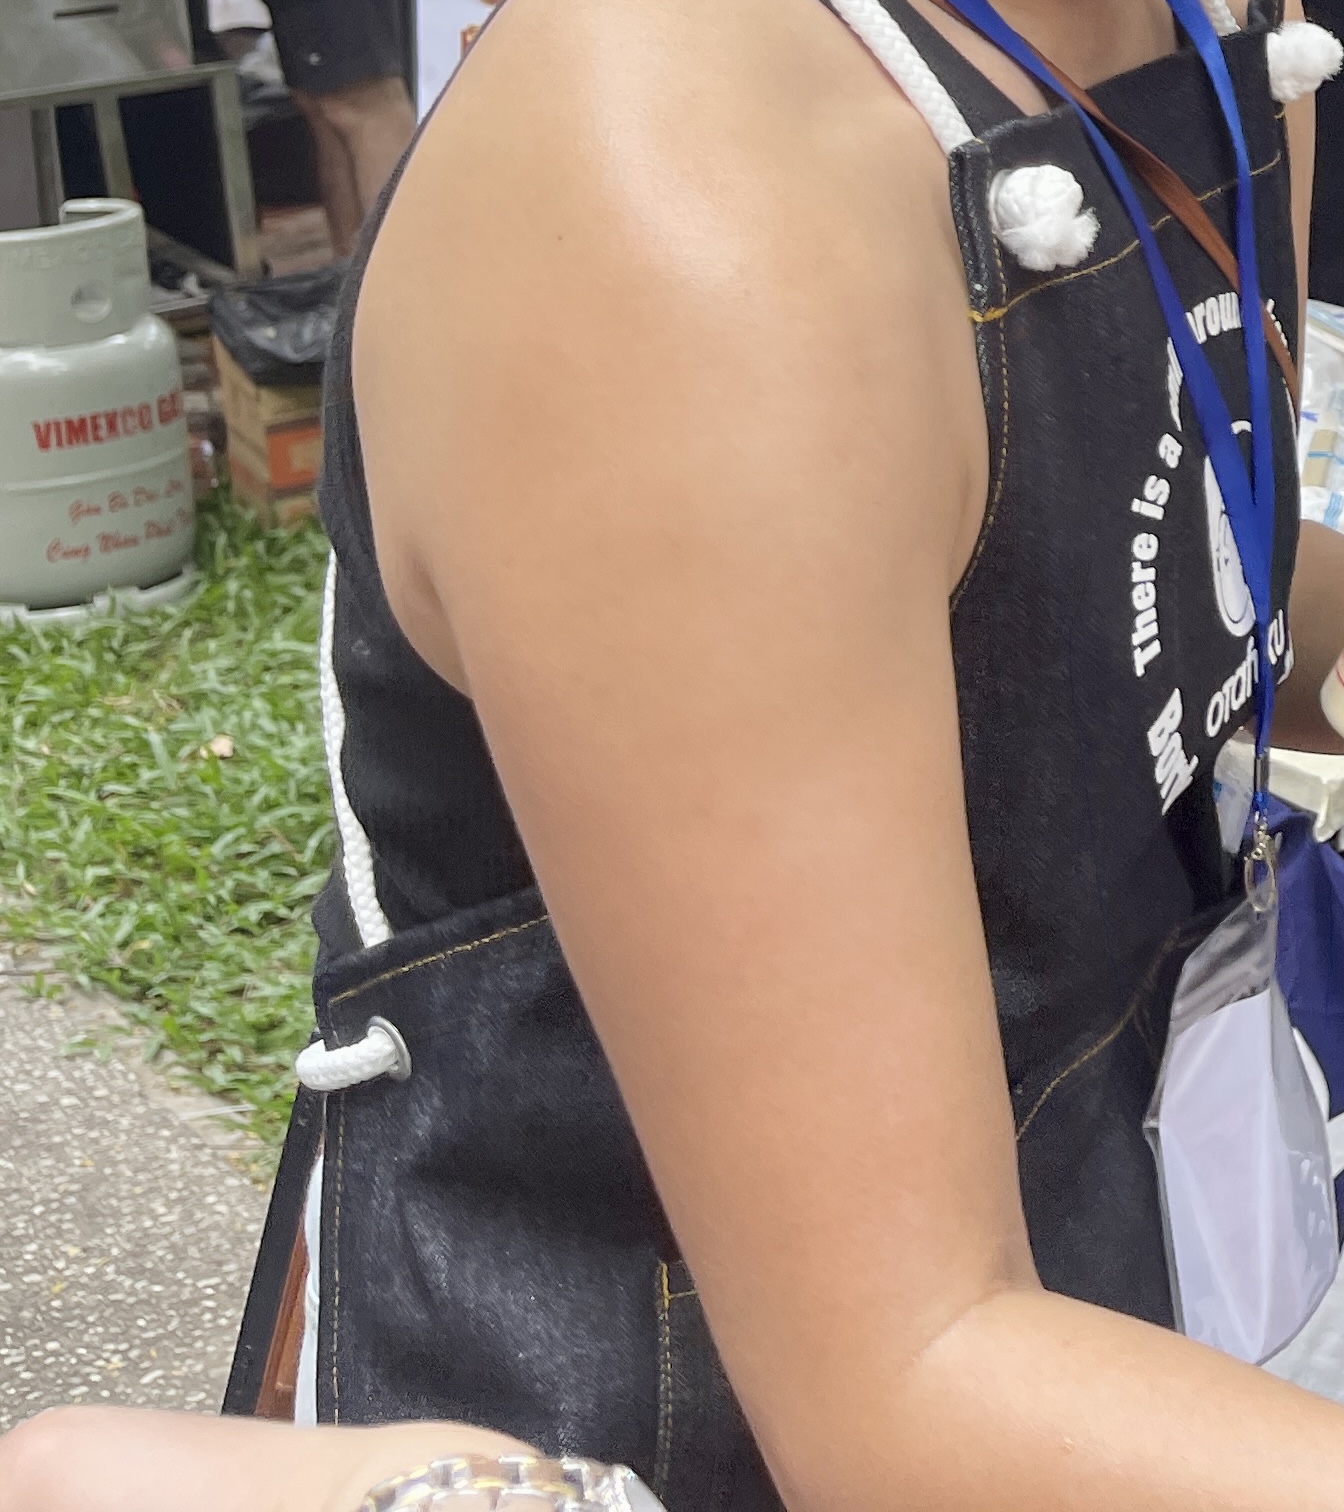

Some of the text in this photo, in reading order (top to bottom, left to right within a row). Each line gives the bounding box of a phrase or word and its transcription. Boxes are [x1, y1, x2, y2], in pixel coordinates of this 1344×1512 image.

[32, 402, 152, 453] VIMEXCO
[1158, 433, 1183, 469] a
[1131, 474, 1171, 521] is
[1132, 531, 1162, 677] There
